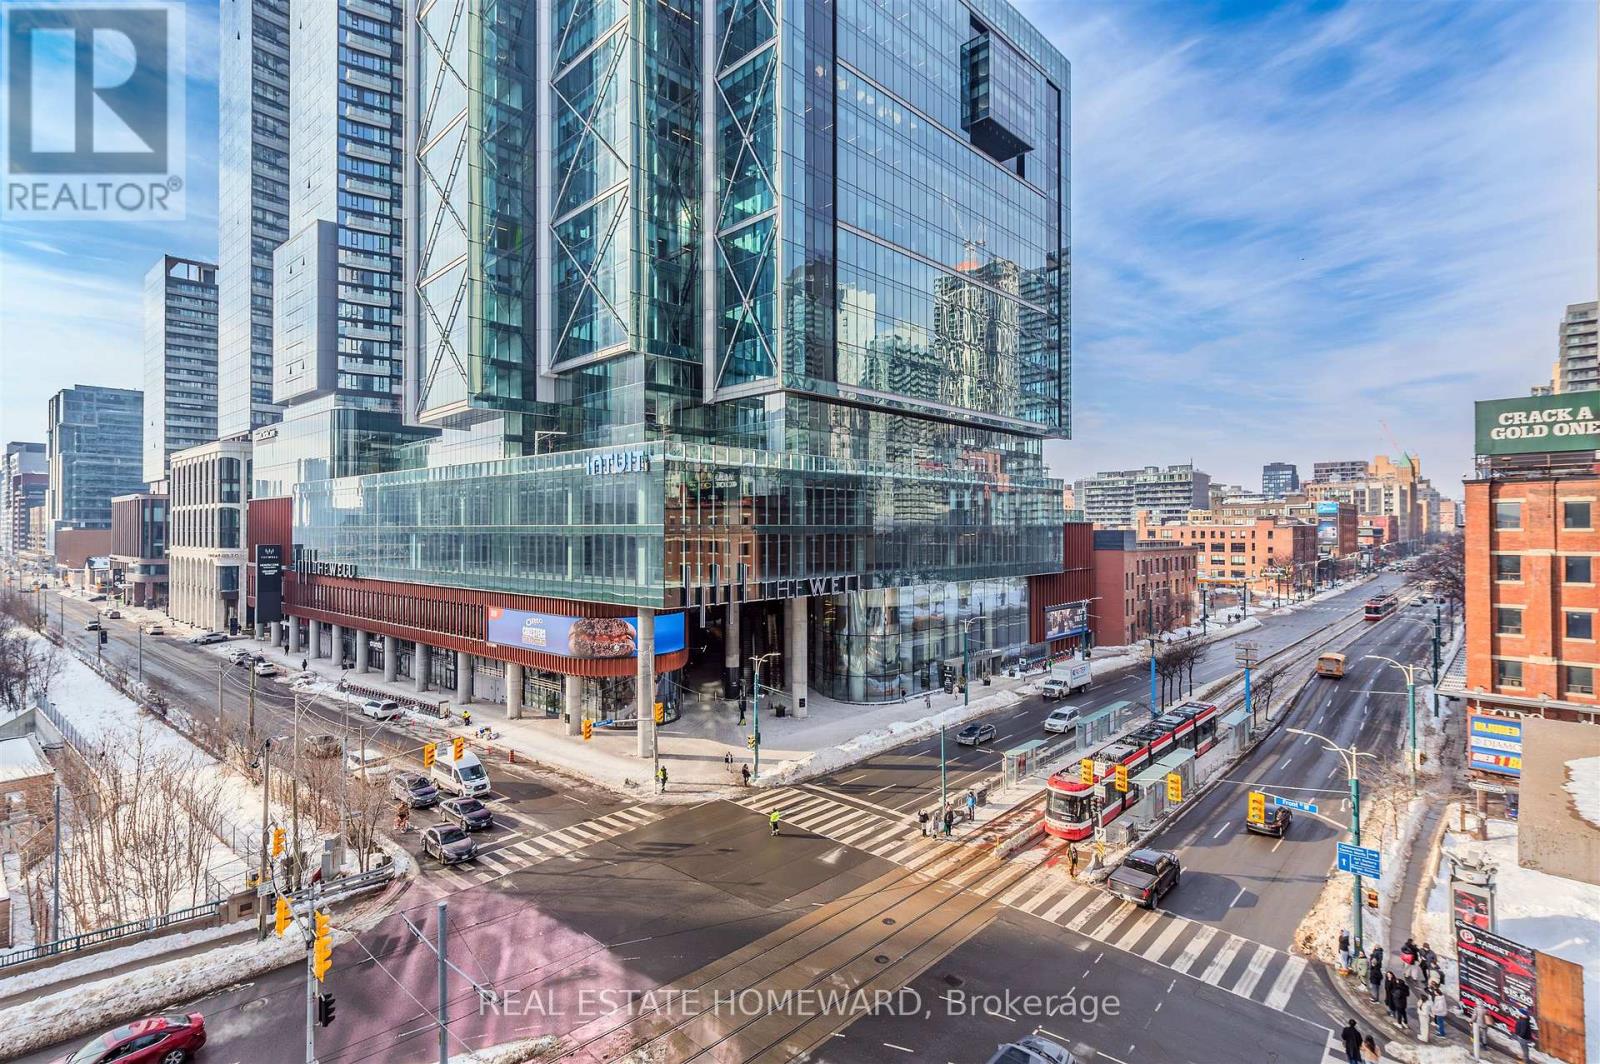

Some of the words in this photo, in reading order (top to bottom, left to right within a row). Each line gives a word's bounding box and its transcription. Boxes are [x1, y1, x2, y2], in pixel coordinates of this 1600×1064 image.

[1498, 407, 1574, 426] CRACK
[1576, 405, 1594, 420] A
[1490, 424, 1549, 440] GOLD
[1552, 420, 1600, 437] ONE
